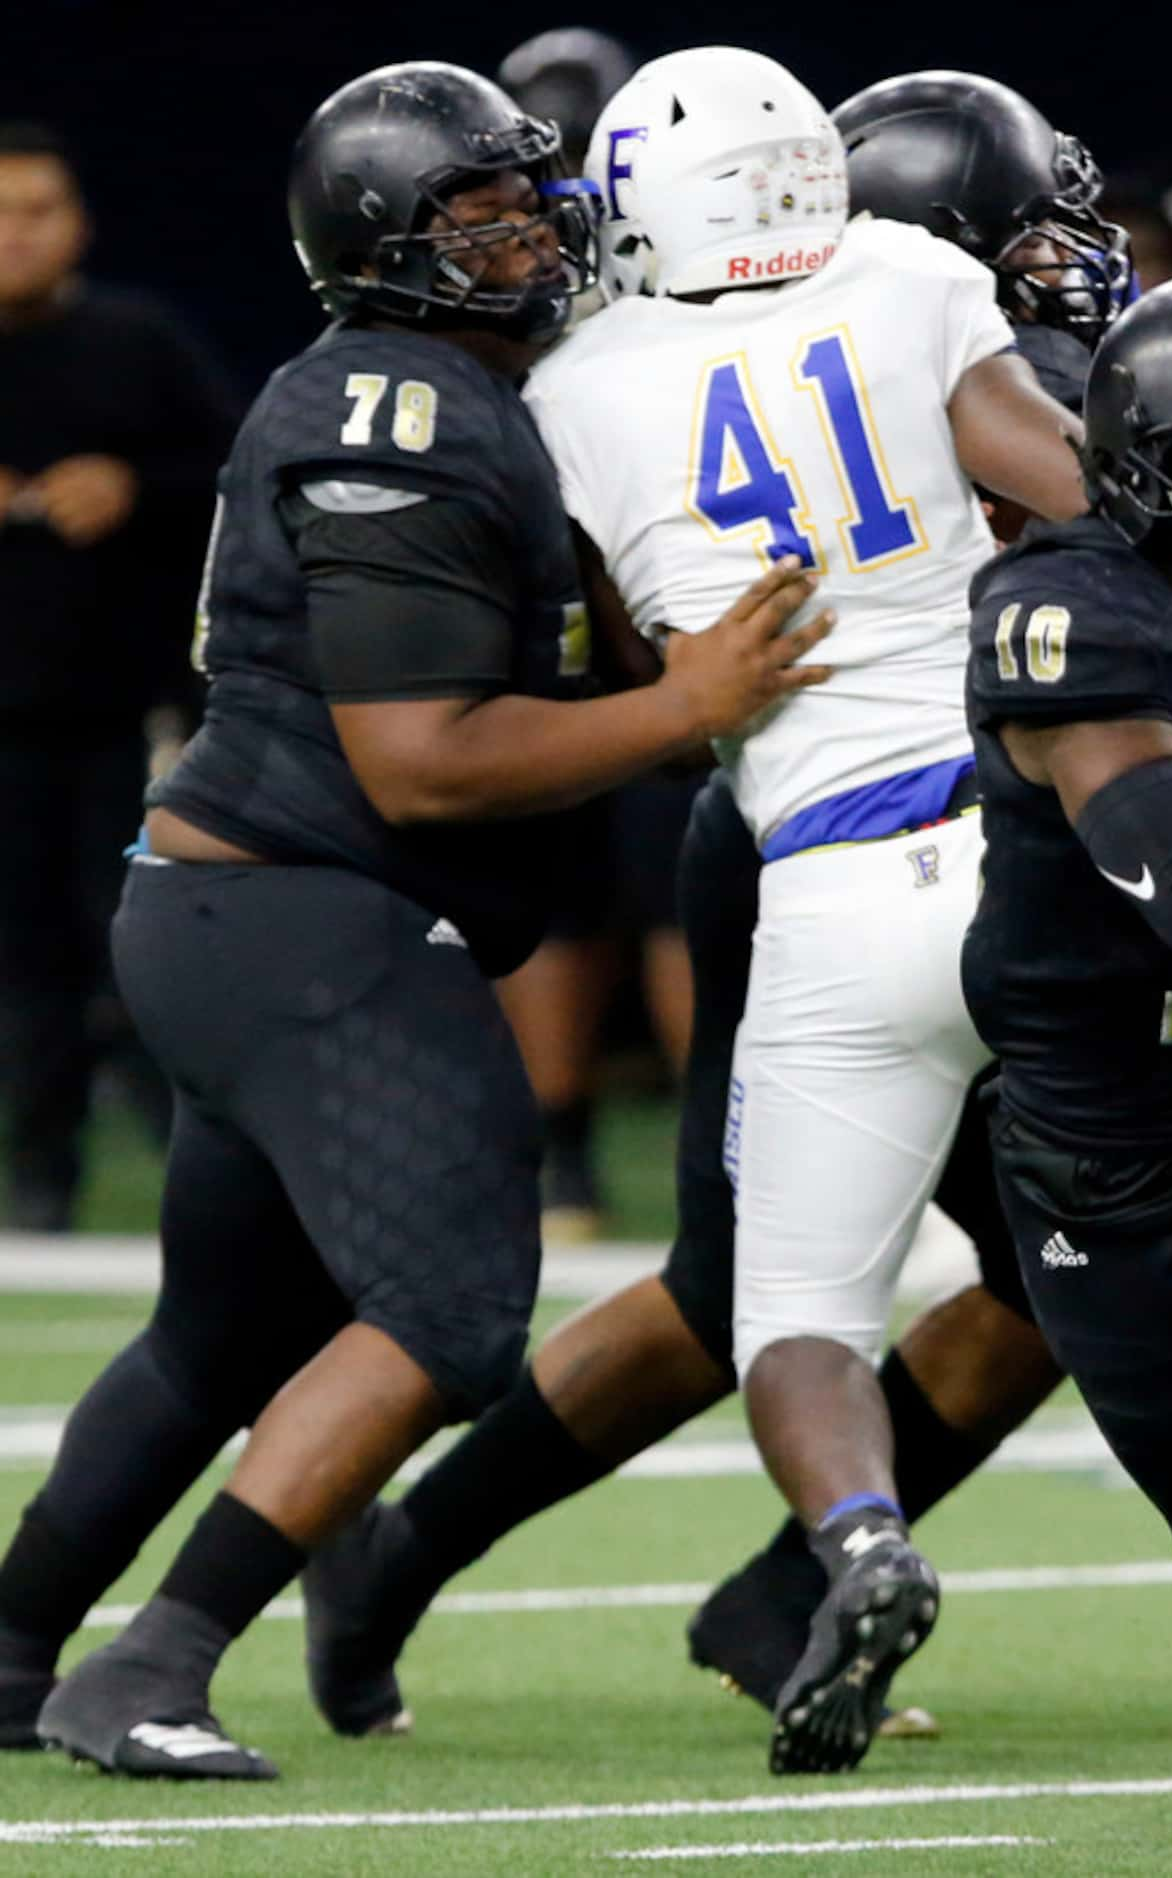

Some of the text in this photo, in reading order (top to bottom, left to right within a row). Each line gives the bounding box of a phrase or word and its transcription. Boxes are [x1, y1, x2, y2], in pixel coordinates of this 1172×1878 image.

[607, 127, 649, 221] F
[728, 245, 836, 280] Riddell
[341, 372, 438, 453] 78
[684, 322, 931, 576] 41
[994, 602, 1072, 684] 10
